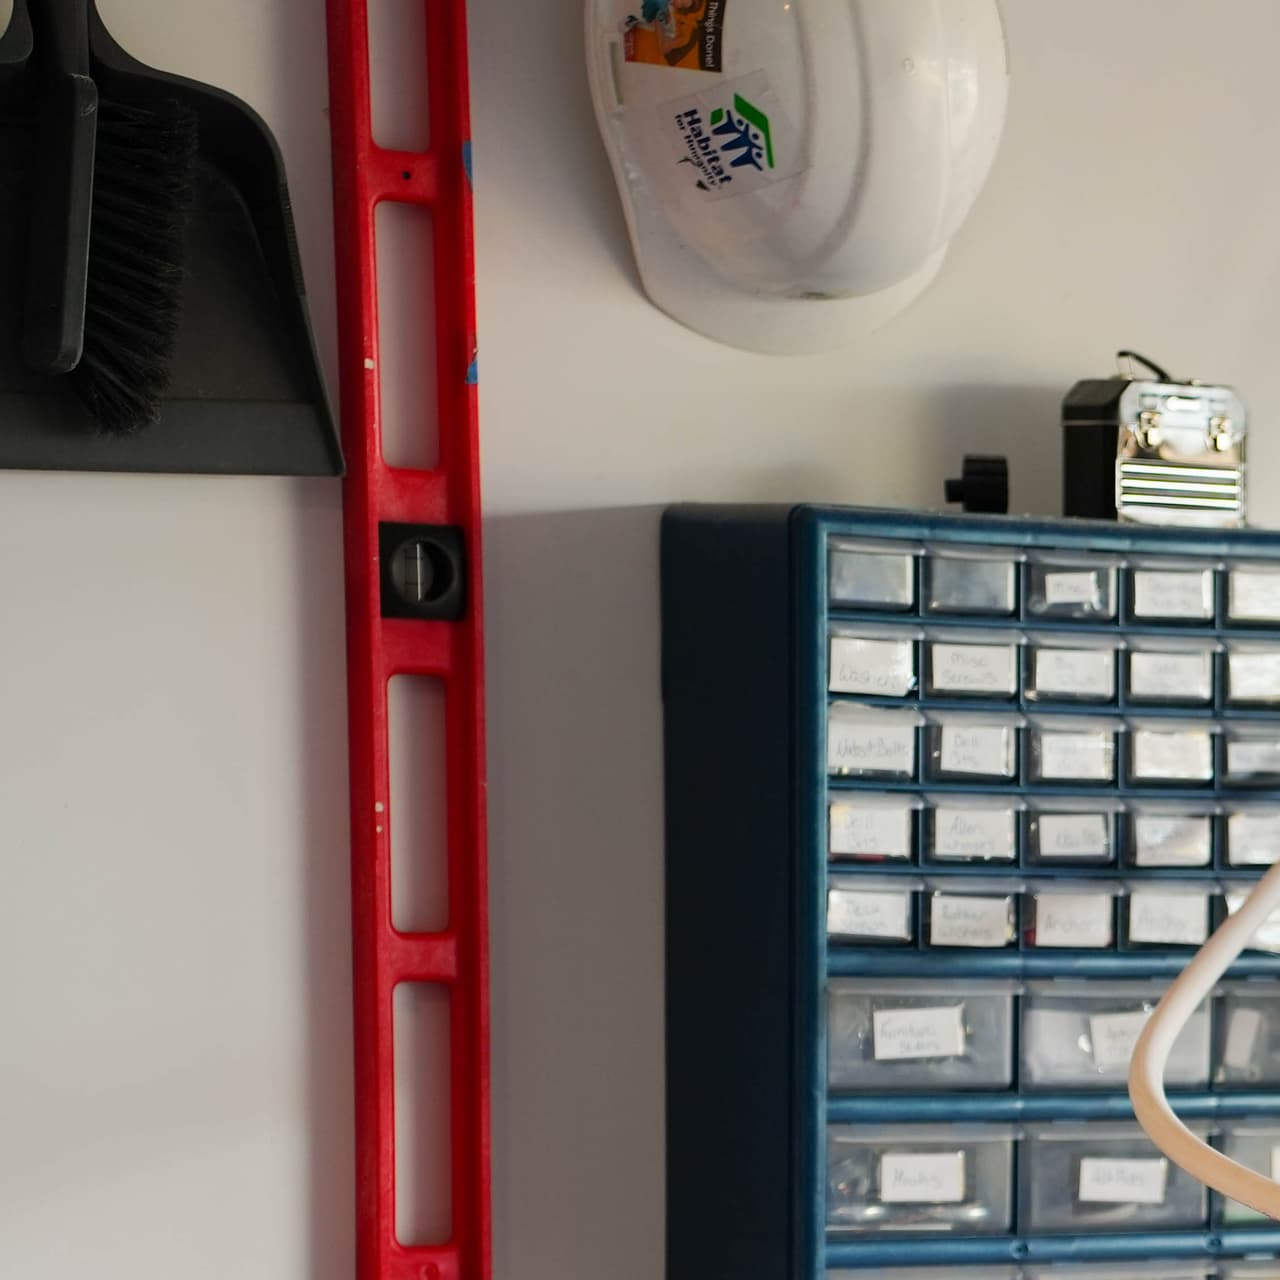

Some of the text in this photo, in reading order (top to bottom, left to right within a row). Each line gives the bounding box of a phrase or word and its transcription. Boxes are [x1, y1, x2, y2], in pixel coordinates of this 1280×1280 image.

[703, 35, 717, 68] Done!
[675, 114, 717, 186] for Humanity
[683, 109, 732, 184] Habitat
